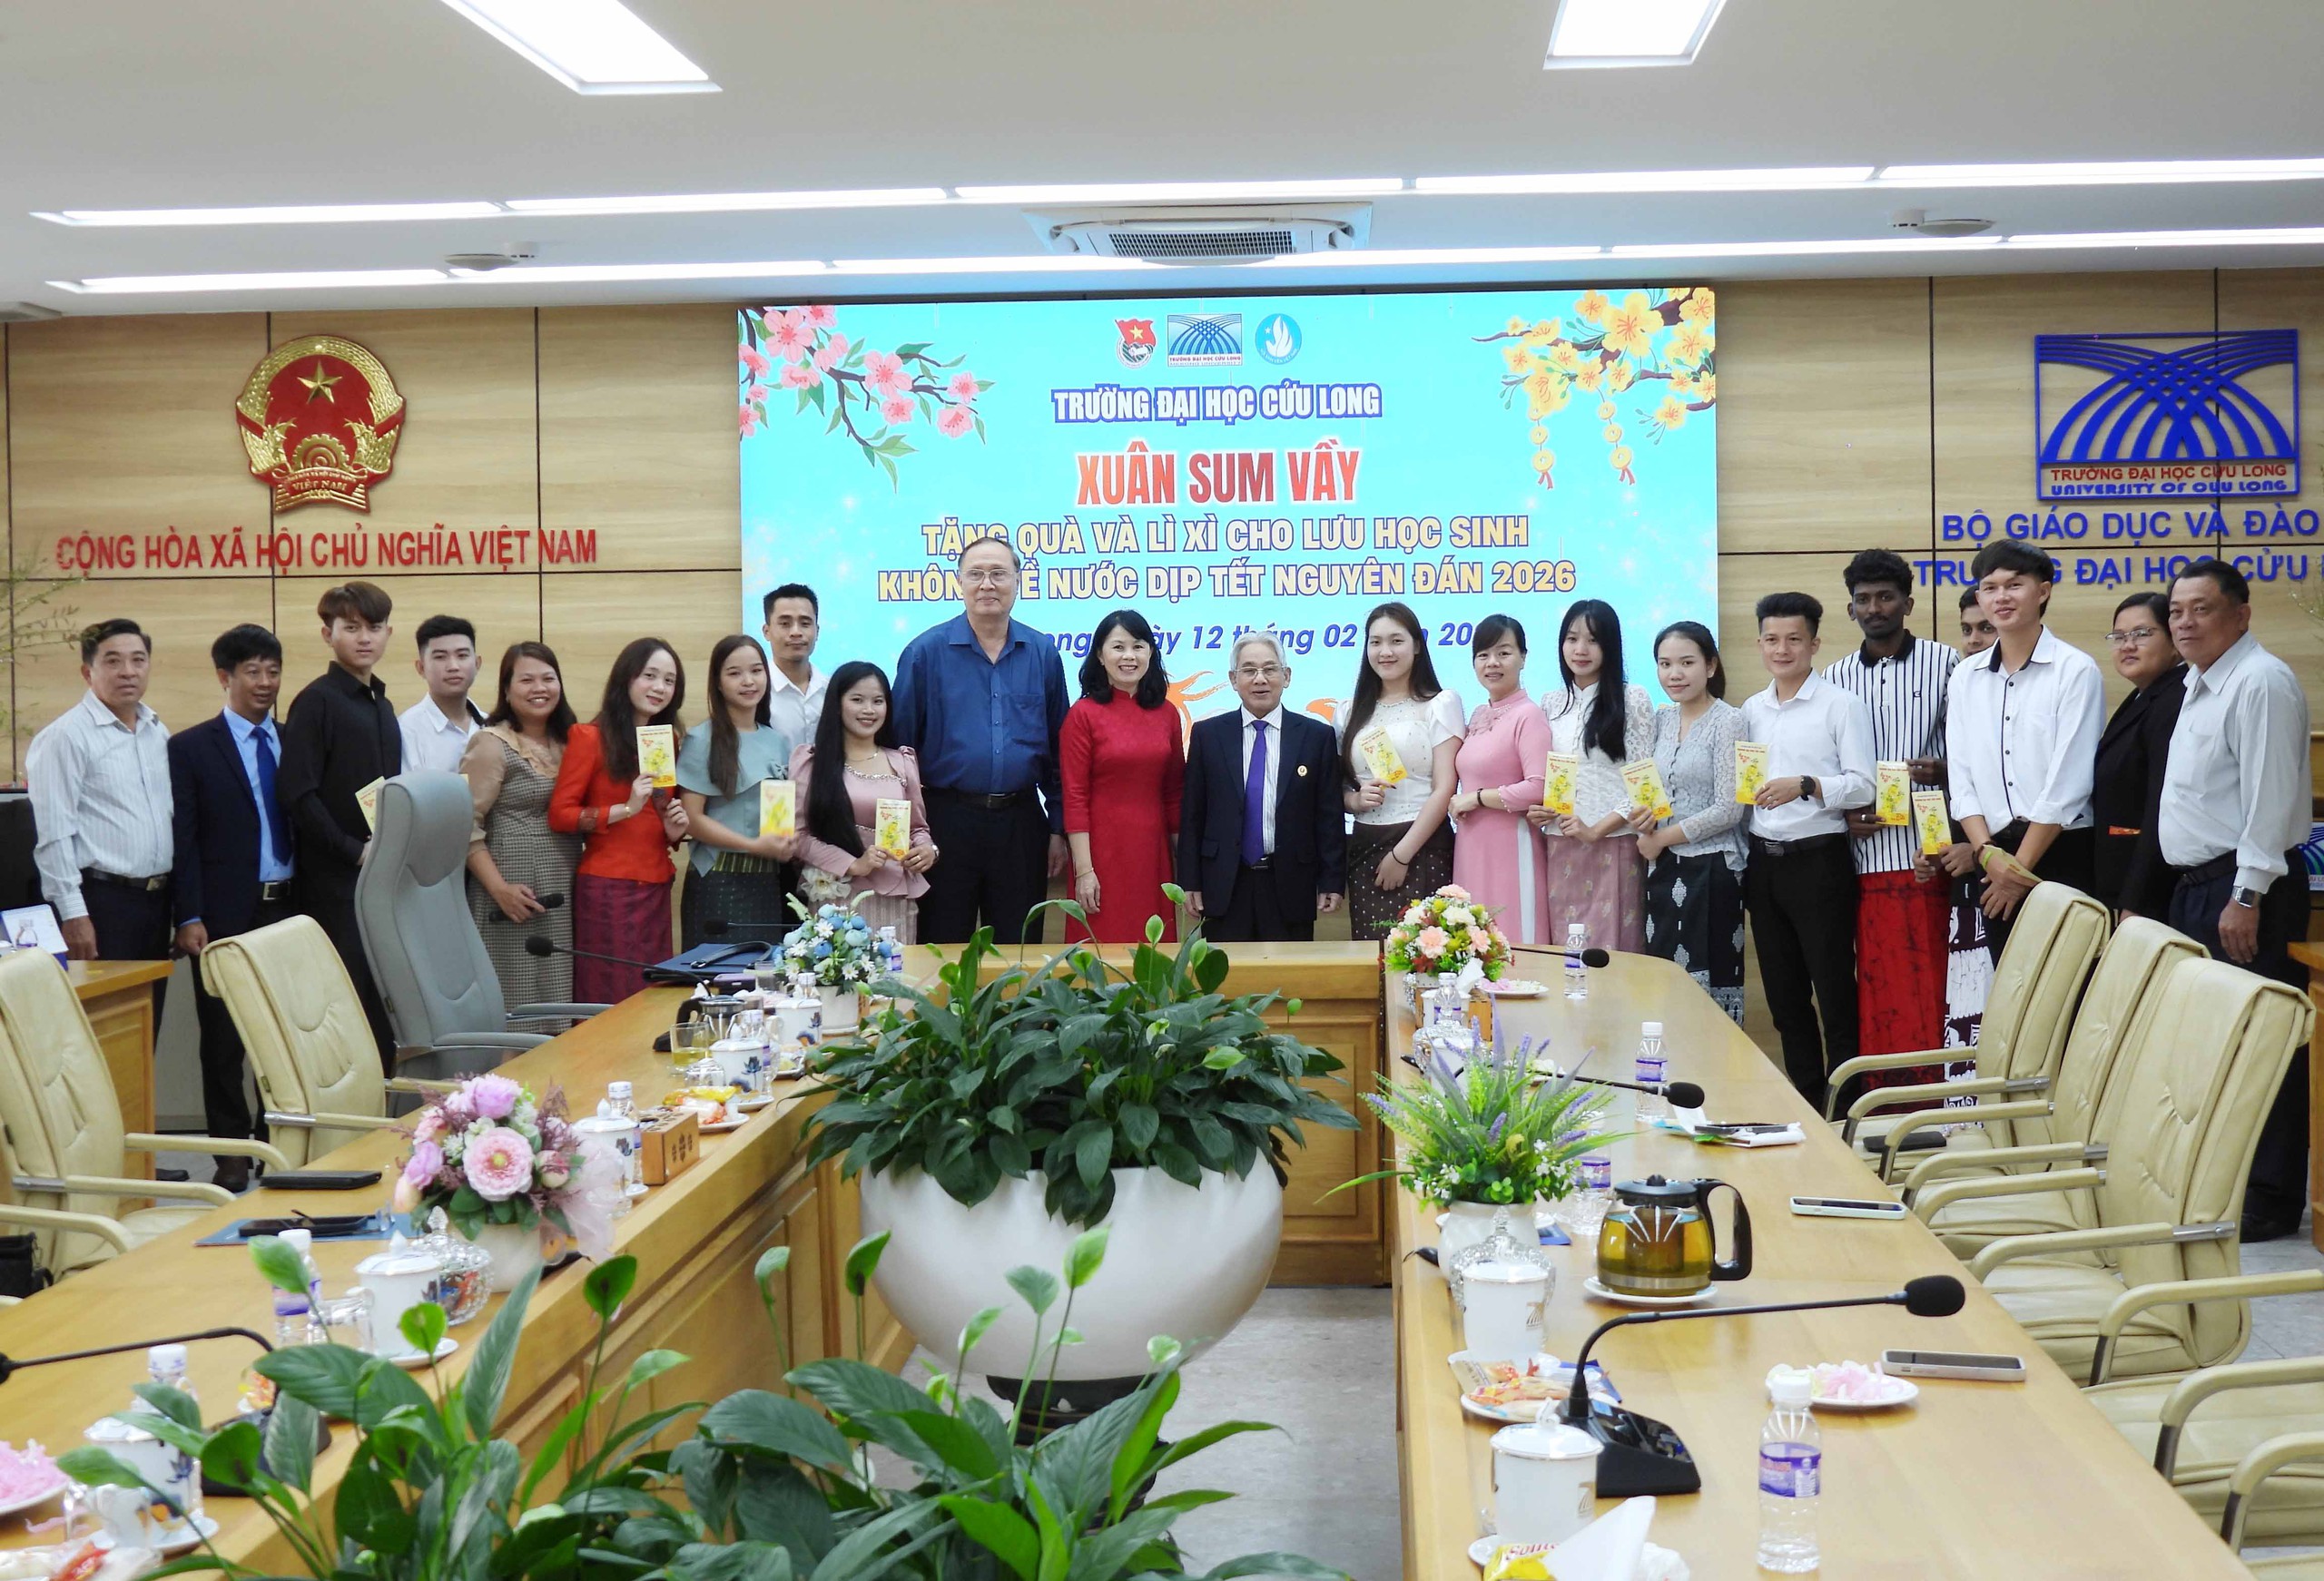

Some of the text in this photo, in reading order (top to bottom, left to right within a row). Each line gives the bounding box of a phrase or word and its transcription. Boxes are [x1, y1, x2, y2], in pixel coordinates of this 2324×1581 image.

[1051, 378, 1382, 426] TRƯỜNG ĐẠI HỌC CỬU LONG
[1078, 439, 1359, 505] XUÂN SUM VẦY
[2051, 466, 2122, 481] TRƯỜNG
[2128, 466, 2156, 481] ĐẠI
[2161, 466, 2195, 482] HỌC
[2242, 464, 2287, 476] LONG
[2051, 482, 2155, 496] UNIVERSITY
[2161, 482, 2187, 494] OF
[2239, 479, 2287, 492] LONG
[1017, 516, 1086, 559] QUÀ
[1092, 515, 1140, 554] VÀ
[1147, 516, 1177, 553] LÌ
[1185, 515, 1217, 552] XÌ
[1226, 519, 1295, 552] CHO
[1303, 516, 1365, 551] LƯU
[1374, 517, 1442, 555] HỌC
[1450, 516, 1529, 548] SINH
[1943, 503, 2319, 548] BỘ GIÁO DỤC VÀ ĐÀO
[57, 522, 596, 578] CỘNG HÒA XÃ HỘI CHỦ NGHĨA VIỆT NAM
[2074, 557, 2132, 589] ĐẠI
[2231, 548, 2308, 582] CỬU
[878, 563, 962, 602] KHÔN
[1048, 559, 1139, 600] NƯỚC
[1146, 565, 1201, 604] DỊP
[1210, 556, 1265, 597] TẾT
[1274, 555, 1404, 596] NGUYÊN
[1413, 555, 1483, 594] ĐÁN
[1492, 560, 1576, 593] 2026
[1193, 625, 1224, 650] 12
[1323, 624, 1358, 648] 02
[1438, 623, 1474, 646] 20
